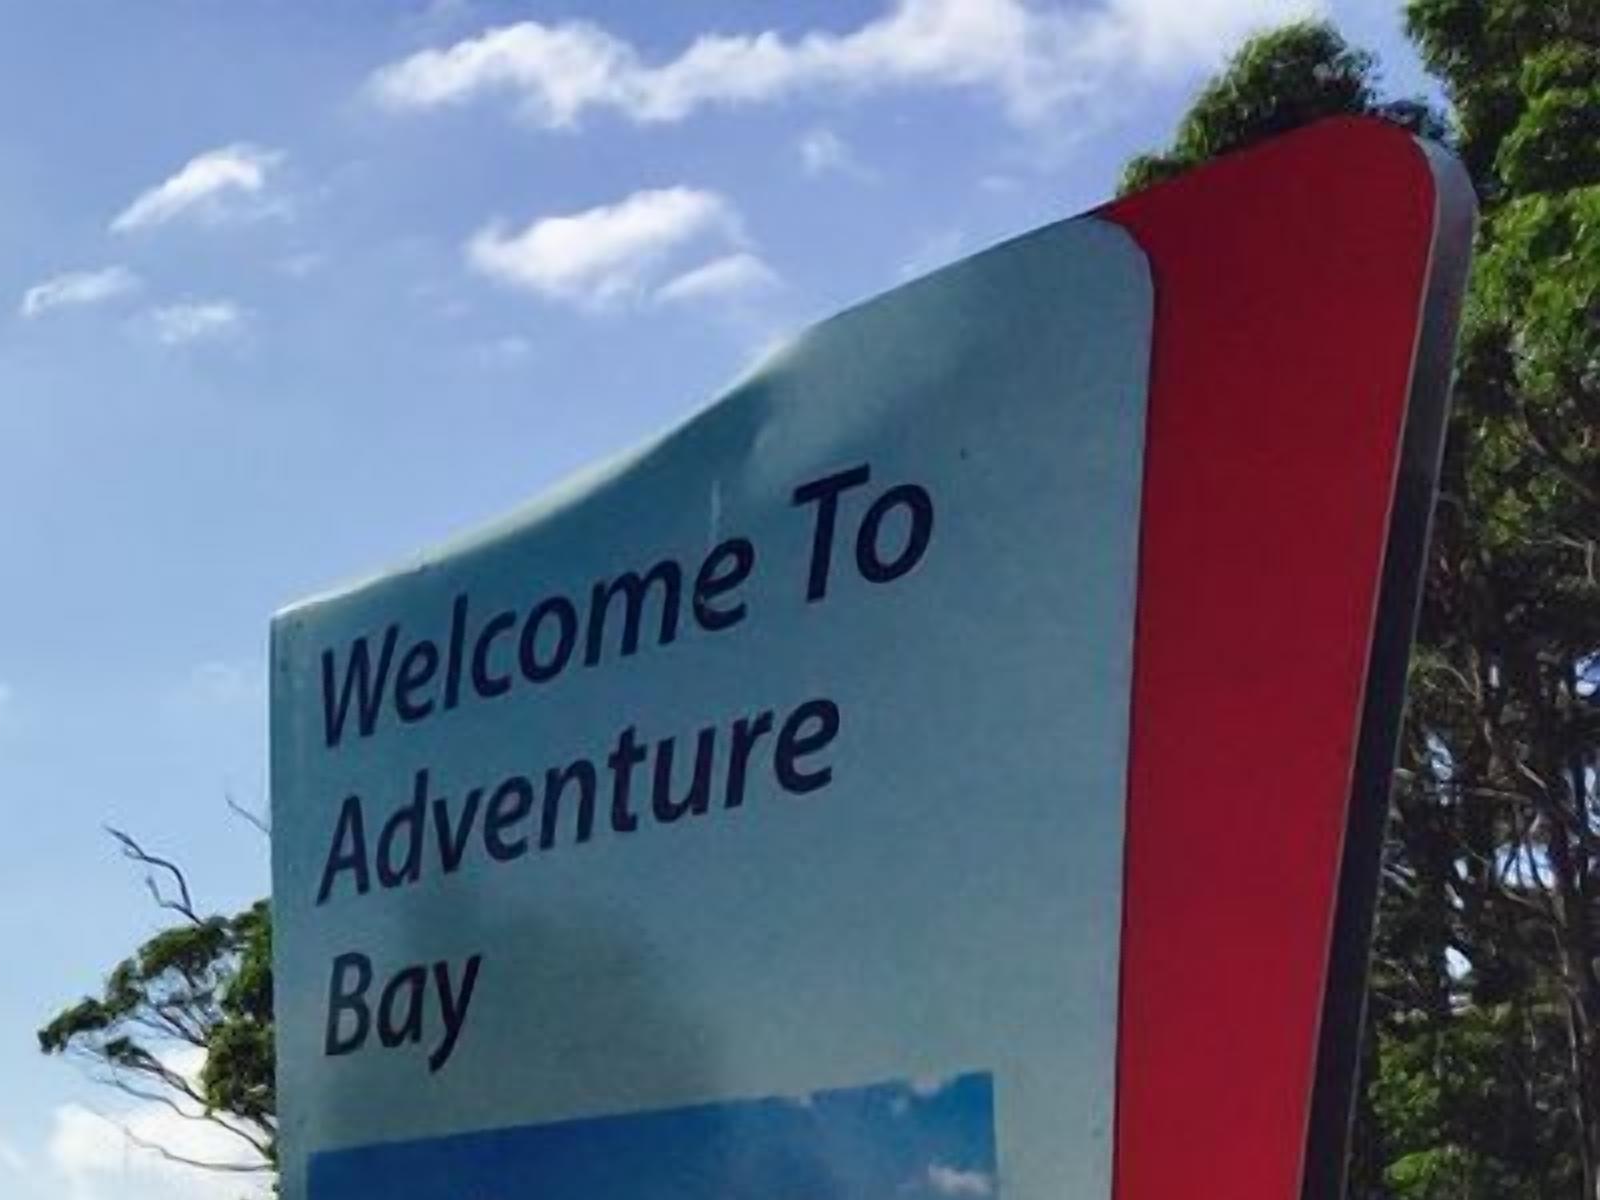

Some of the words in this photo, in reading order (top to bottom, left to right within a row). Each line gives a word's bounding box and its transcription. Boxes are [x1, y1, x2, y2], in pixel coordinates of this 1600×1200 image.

[320, 536, 756, 749] Welcome
[791, 462, 936, 604] To
[316, 698, 842, 906] Adventure
[324, 951, 483, 1075] Bay
